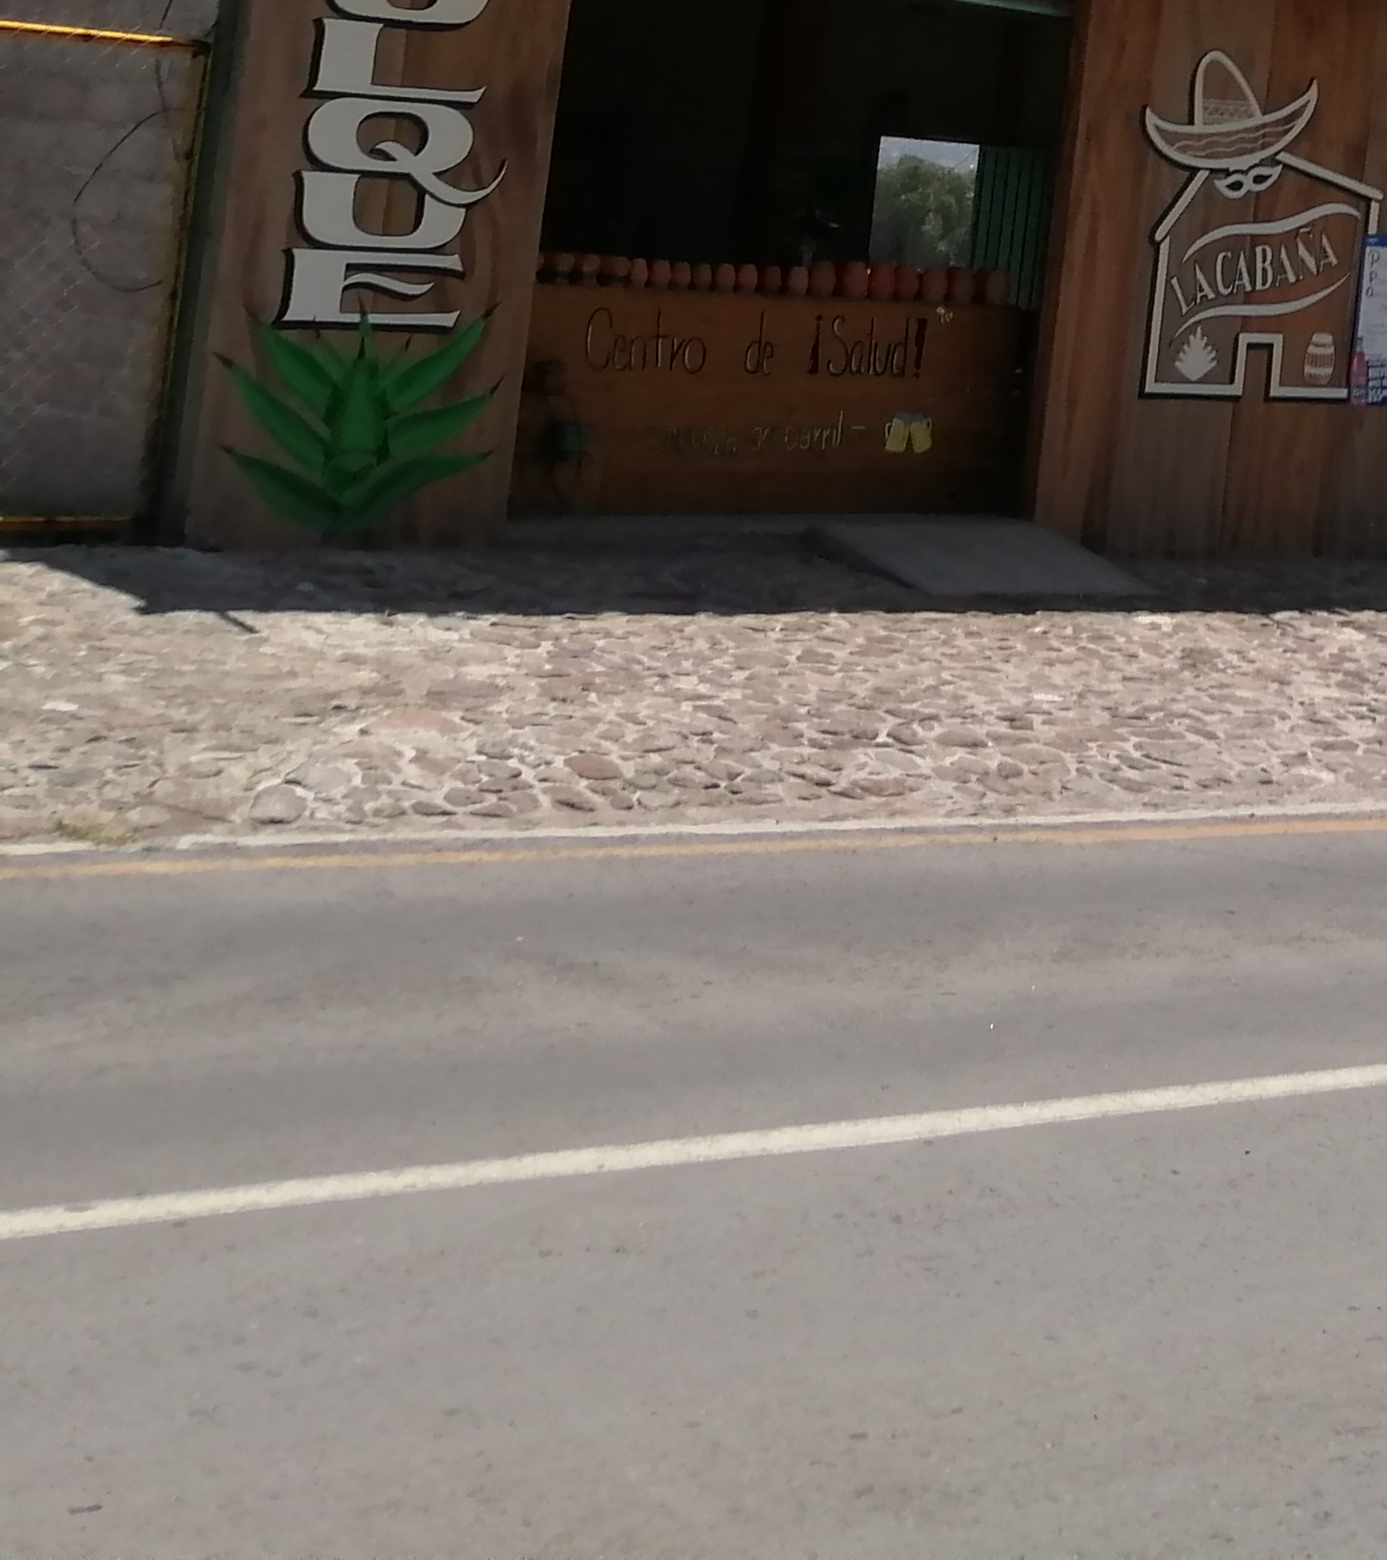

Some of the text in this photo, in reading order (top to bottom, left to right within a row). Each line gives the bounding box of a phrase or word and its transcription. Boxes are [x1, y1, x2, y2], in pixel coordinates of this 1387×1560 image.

[1170, 256, 1215, 317] LA
[1213, 226, 1339, 295] CABAÑA
[585, 307, 707, 375] Centro
[743, 309, 776, 376] de
